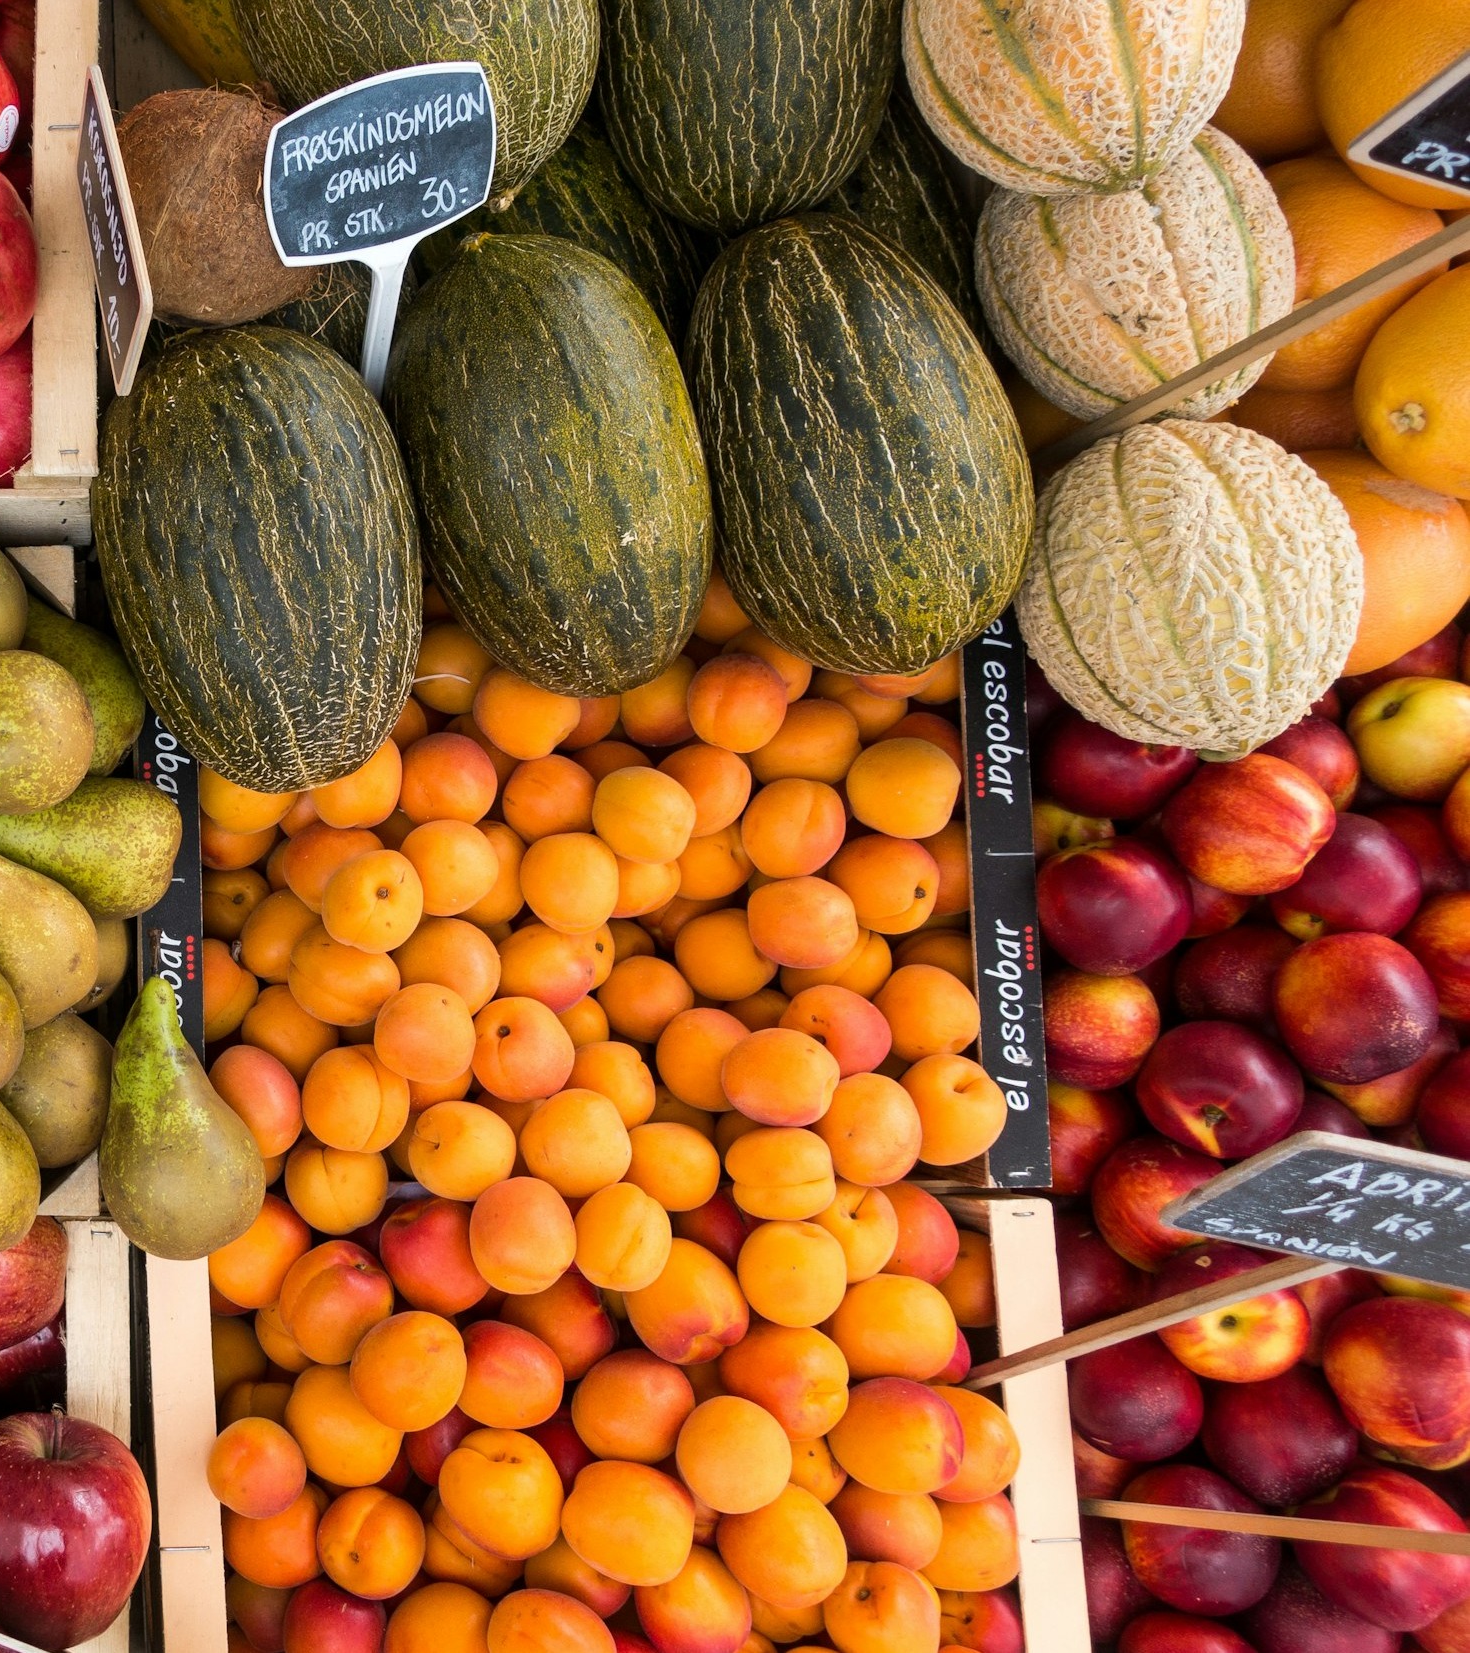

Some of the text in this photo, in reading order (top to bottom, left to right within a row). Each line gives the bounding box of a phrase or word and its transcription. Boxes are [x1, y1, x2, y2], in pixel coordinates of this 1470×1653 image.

[299, 219, 339, 254] PR.
[344, 203, 394, 238] STK.
[324, 152, 418, 204] SPANIEN
[982, 617, 1025, 805] el escobar
[983, 917, 1033, 1112] el escobar
